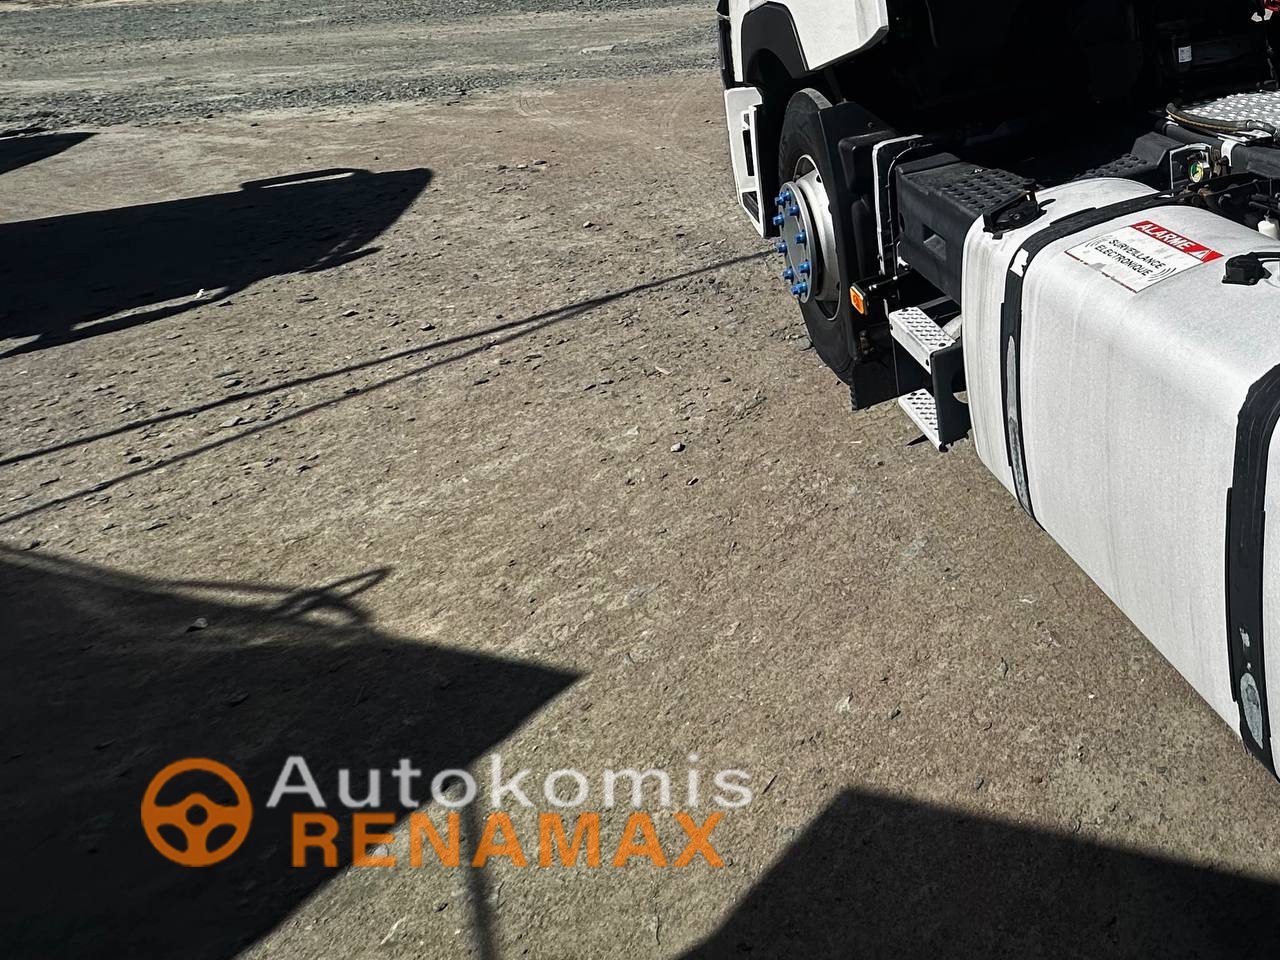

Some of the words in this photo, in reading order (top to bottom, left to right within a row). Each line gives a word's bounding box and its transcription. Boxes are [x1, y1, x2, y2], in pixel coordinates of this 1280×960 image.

[1136, 223, 1193, 253] ALARME
[1094, 244, 1154, 277] ELECTRONIQUE
[1108, 239, 1167, 270] SURVEILLANCE
